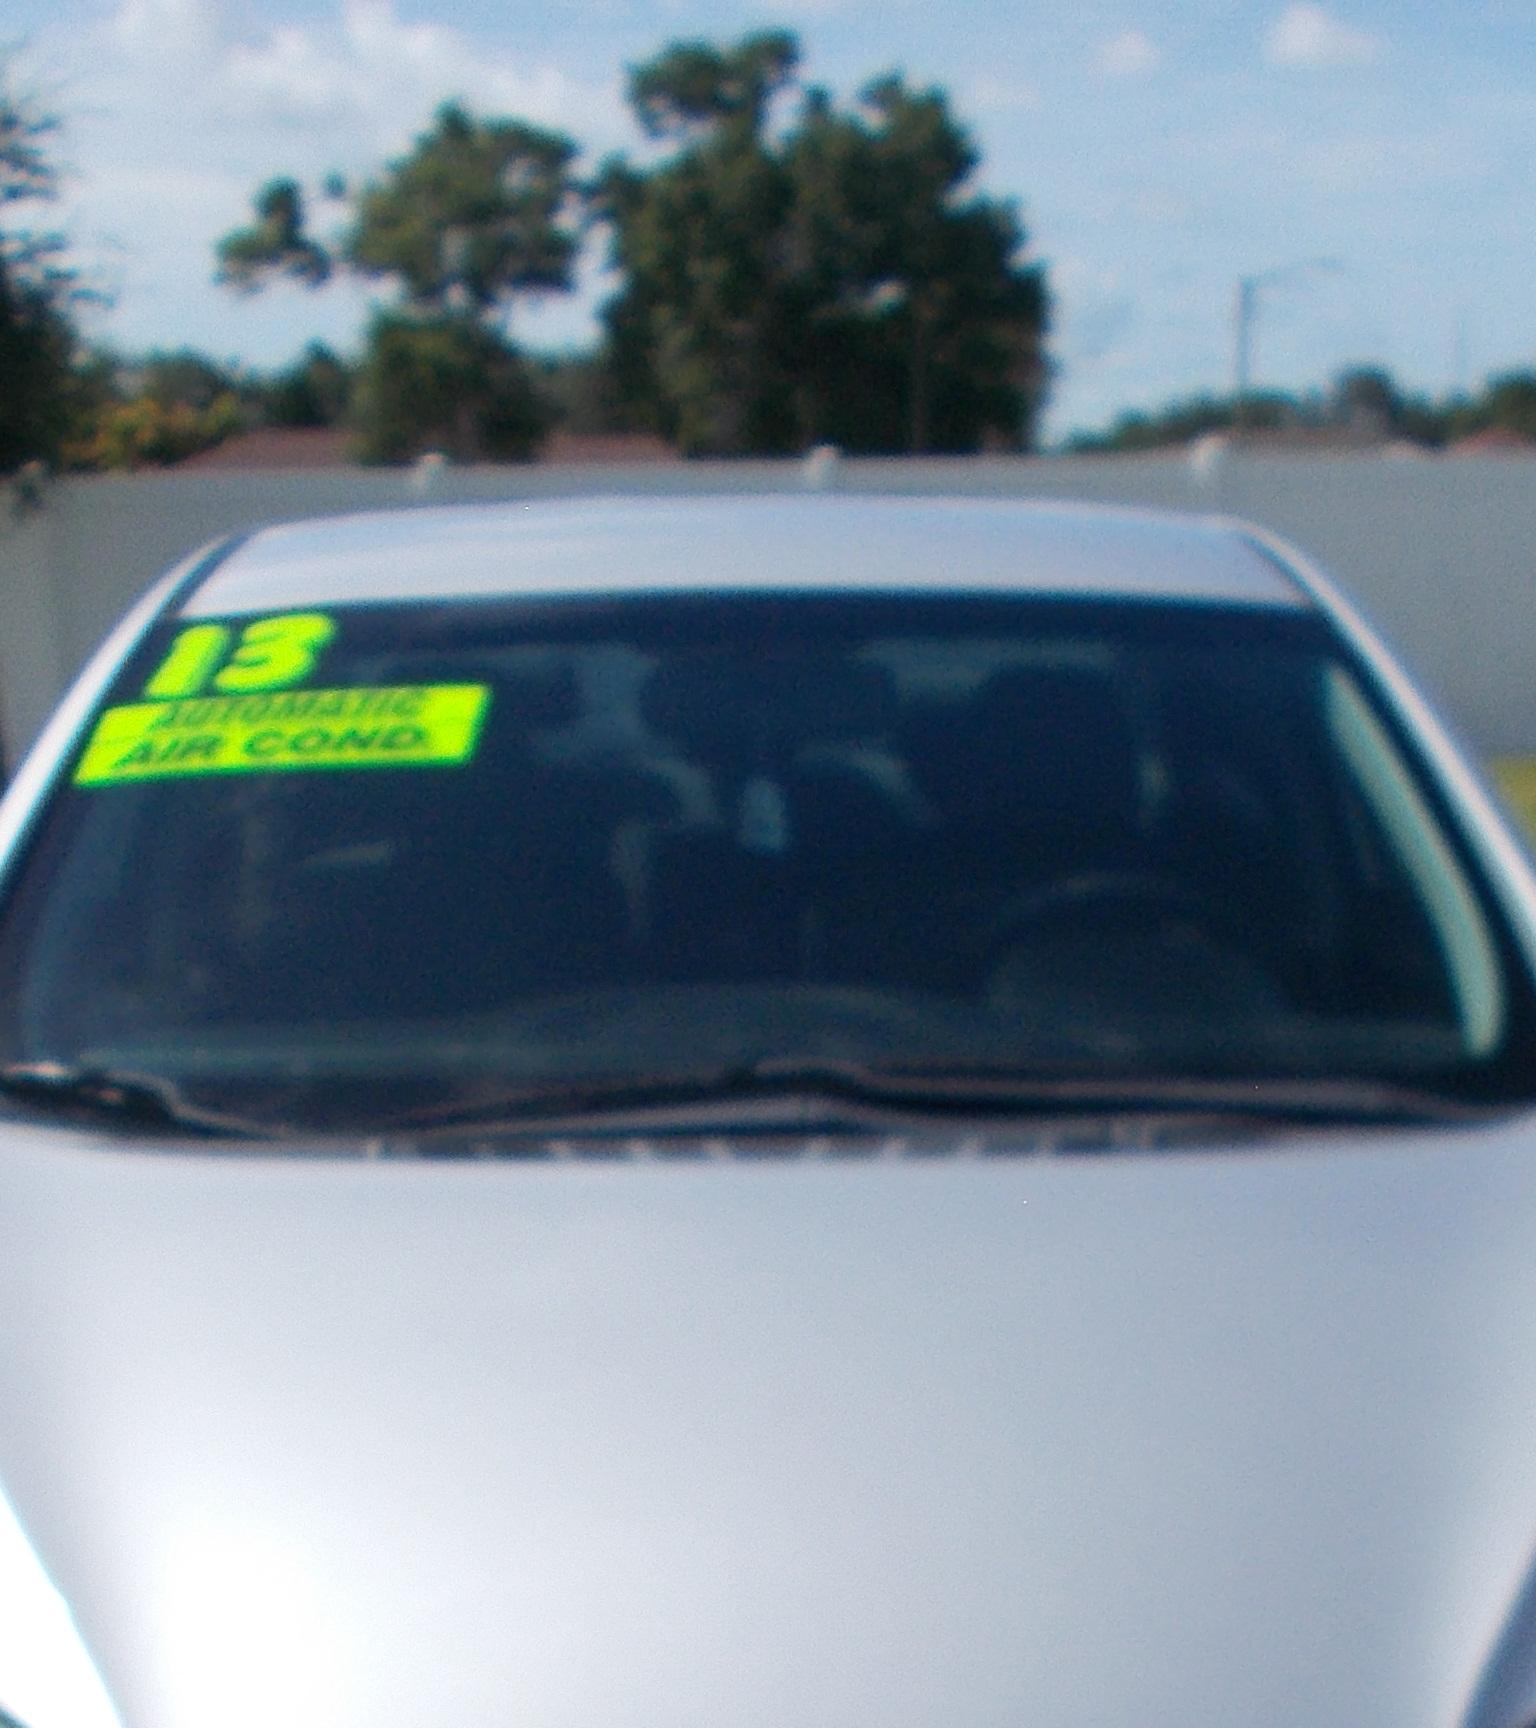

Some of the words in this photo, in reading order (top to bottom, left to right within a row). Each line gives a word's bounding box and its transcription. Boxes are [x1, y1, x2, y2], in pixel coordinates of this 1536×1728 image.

[146, 611, 337, 699] 13
[149, 684, 428, 732] AUTOMATIC
[111, 734, 226, 768] AIR
